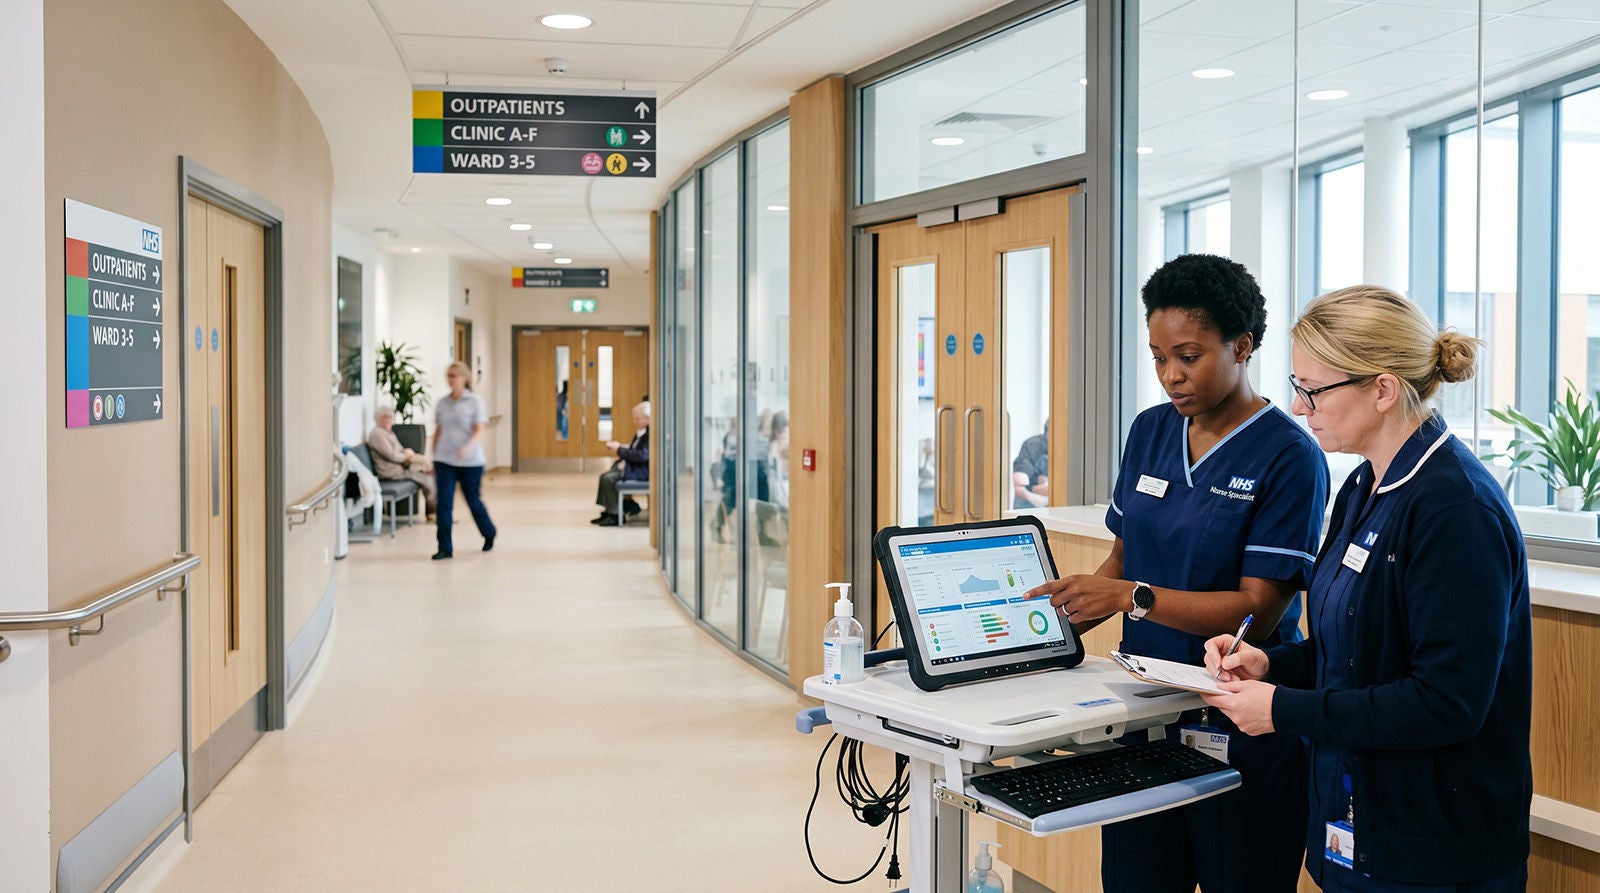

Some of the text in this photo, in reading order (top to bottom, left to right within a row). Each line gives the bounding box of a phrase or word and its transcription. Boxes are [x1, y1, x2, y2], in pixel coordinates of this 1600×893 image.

[451, 98, 565, 116] OUTPATIENTS
[451, 125, 538, 142] CLINIC A-F
[451, 152, 536, 170] WARD 3-5
[142, 229, 159, 252] NHS
[93, 252, 146, 280] OUTPATIENTS
[93, 288, 135, 312] CLINIC A-F
[93, 325, 134, 347] WARD 3-5
[1228, 477, 1255, 491] NHS
